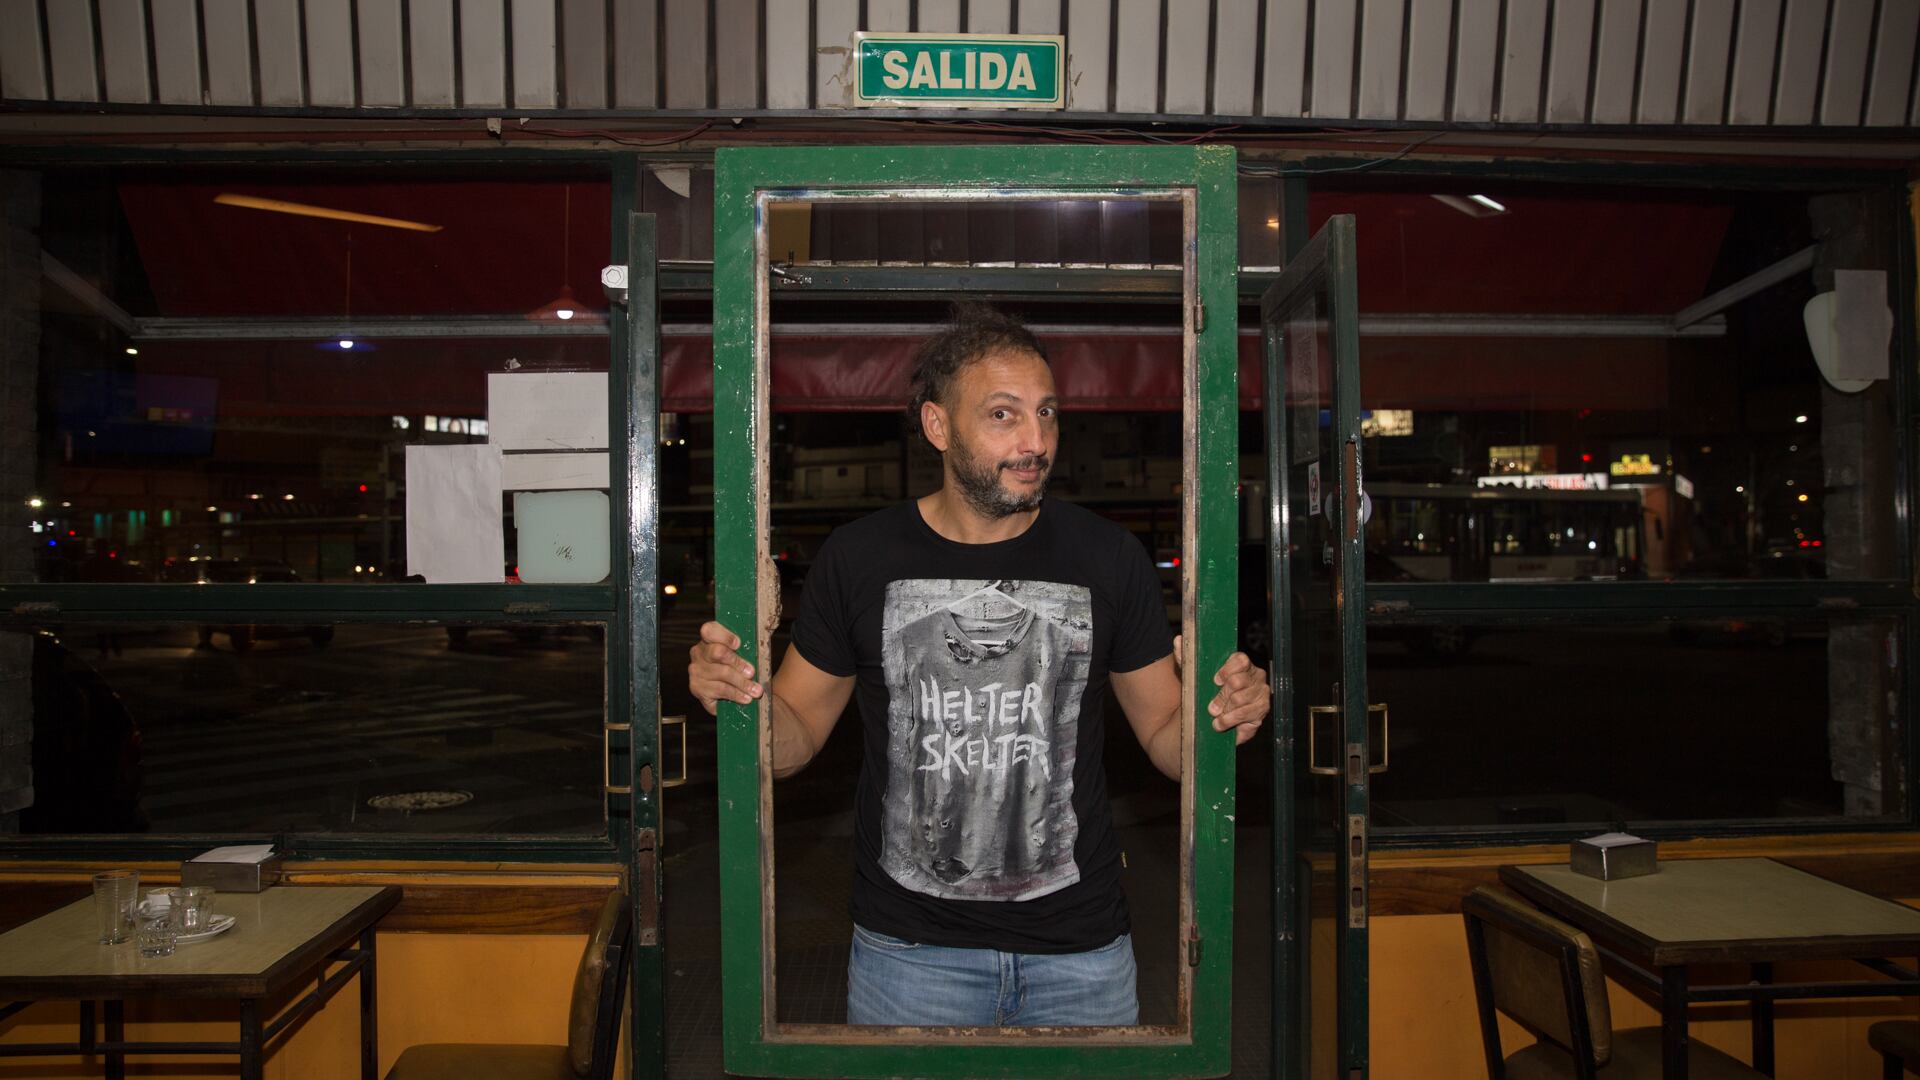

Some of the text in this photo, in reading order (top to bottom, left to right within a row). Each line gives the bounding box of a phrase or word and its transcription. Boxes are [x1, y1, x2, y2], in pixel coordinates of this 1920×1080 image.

[882, 50, 1037, 91] SALIDA
[920, 674, 1047, 736] HELTER
[917, 729, 1051, 782] SKELTER
